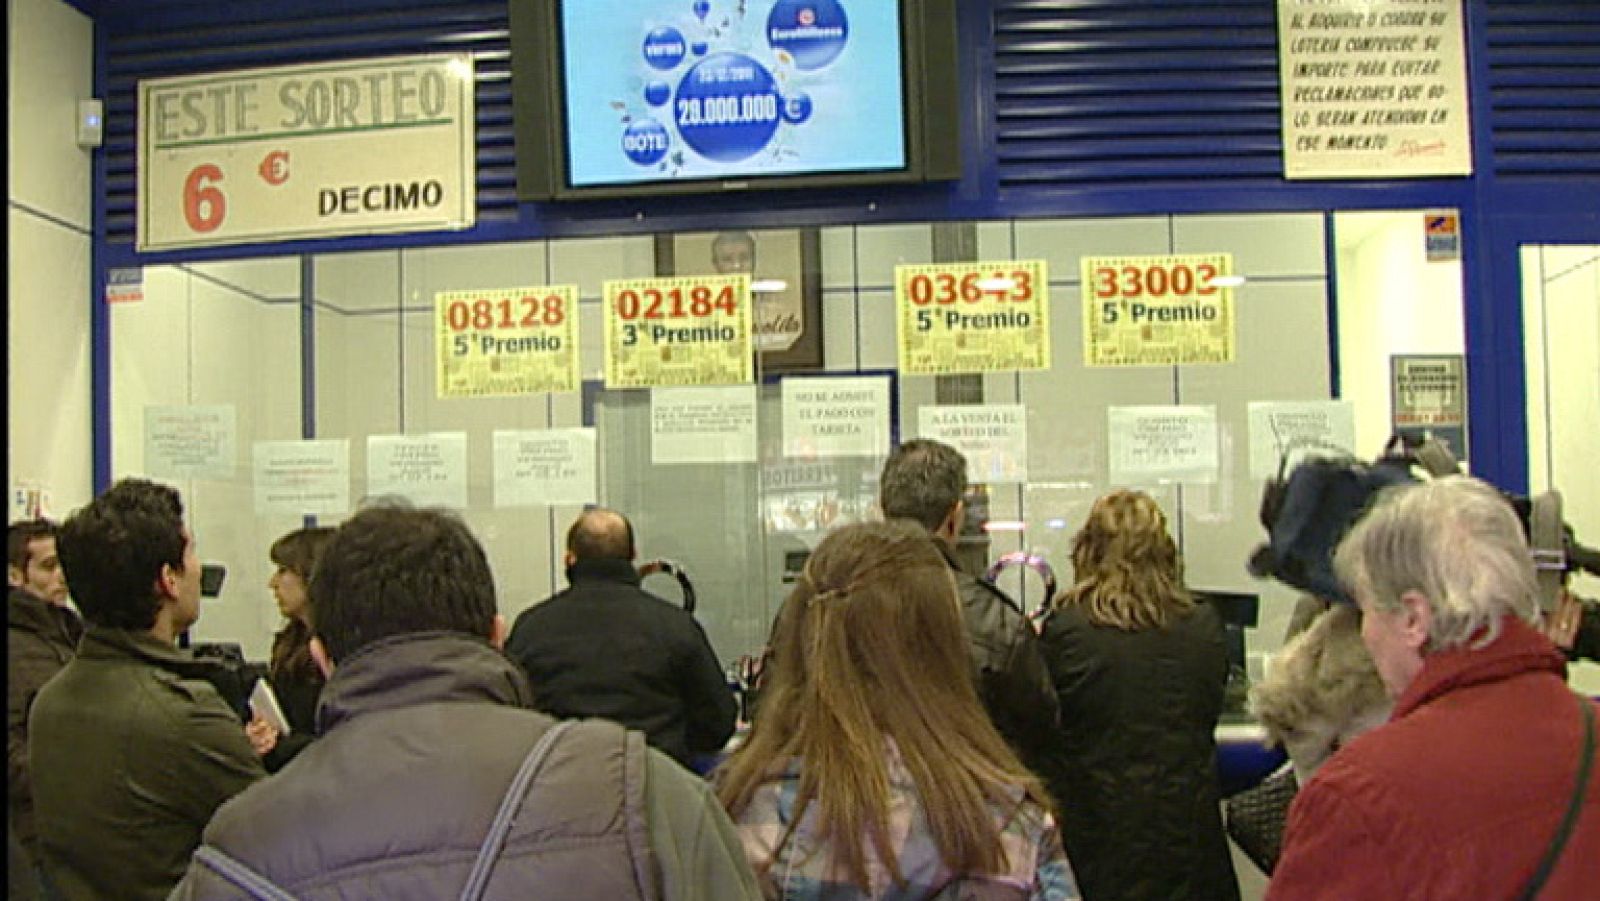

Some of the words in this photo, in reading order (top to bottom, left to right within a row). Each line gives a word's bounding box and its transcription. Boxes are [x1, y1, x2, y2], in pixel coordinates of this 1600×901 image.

[155, 83, 257, 140] ESTE
[278, 67, 445, 128] SORTEO
[183, 162, 226, 233] 6
[258, 150, 290, 186] €
[319, 180, 443, 216] DECIMO
[448, 295, 565, 332] 08128
[617, 284, 737, 321] 02184
[945, 307, 1031, 330] Premio
[1130, 301, 1217, 323] Premio
[481, 330, 562, 355] Premio
[651, 318, 736, 343] Premio
